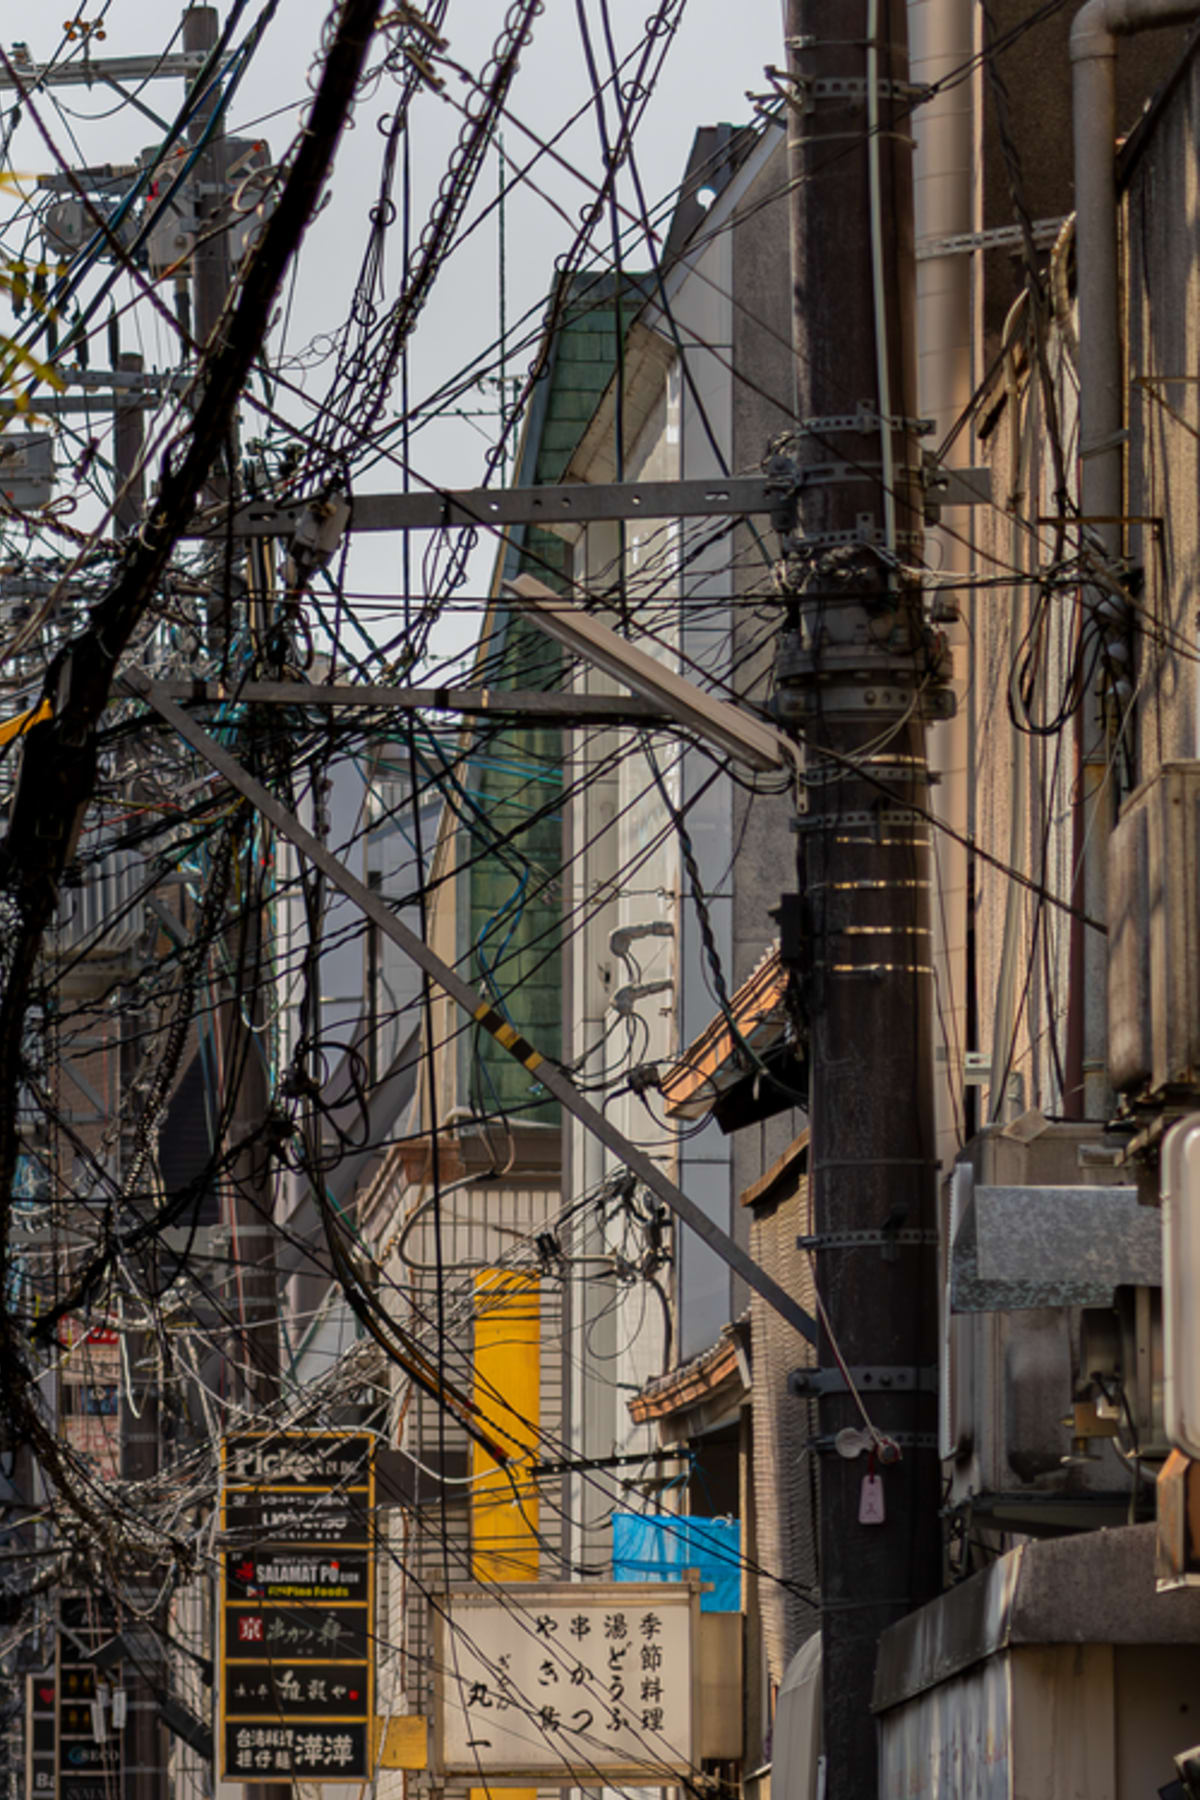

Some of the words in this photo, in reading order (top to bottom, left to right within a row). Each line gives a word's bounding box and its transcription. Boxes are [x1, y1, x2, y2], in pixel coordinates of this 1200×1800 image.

[255, 1563, 318, 1584] SALAMAT
[570, 1614, 595, 1734] 串かつ
[603, 1613, 631, 1731] 湯どうふ
[640, 1612, 664, 1732] 季節料理
